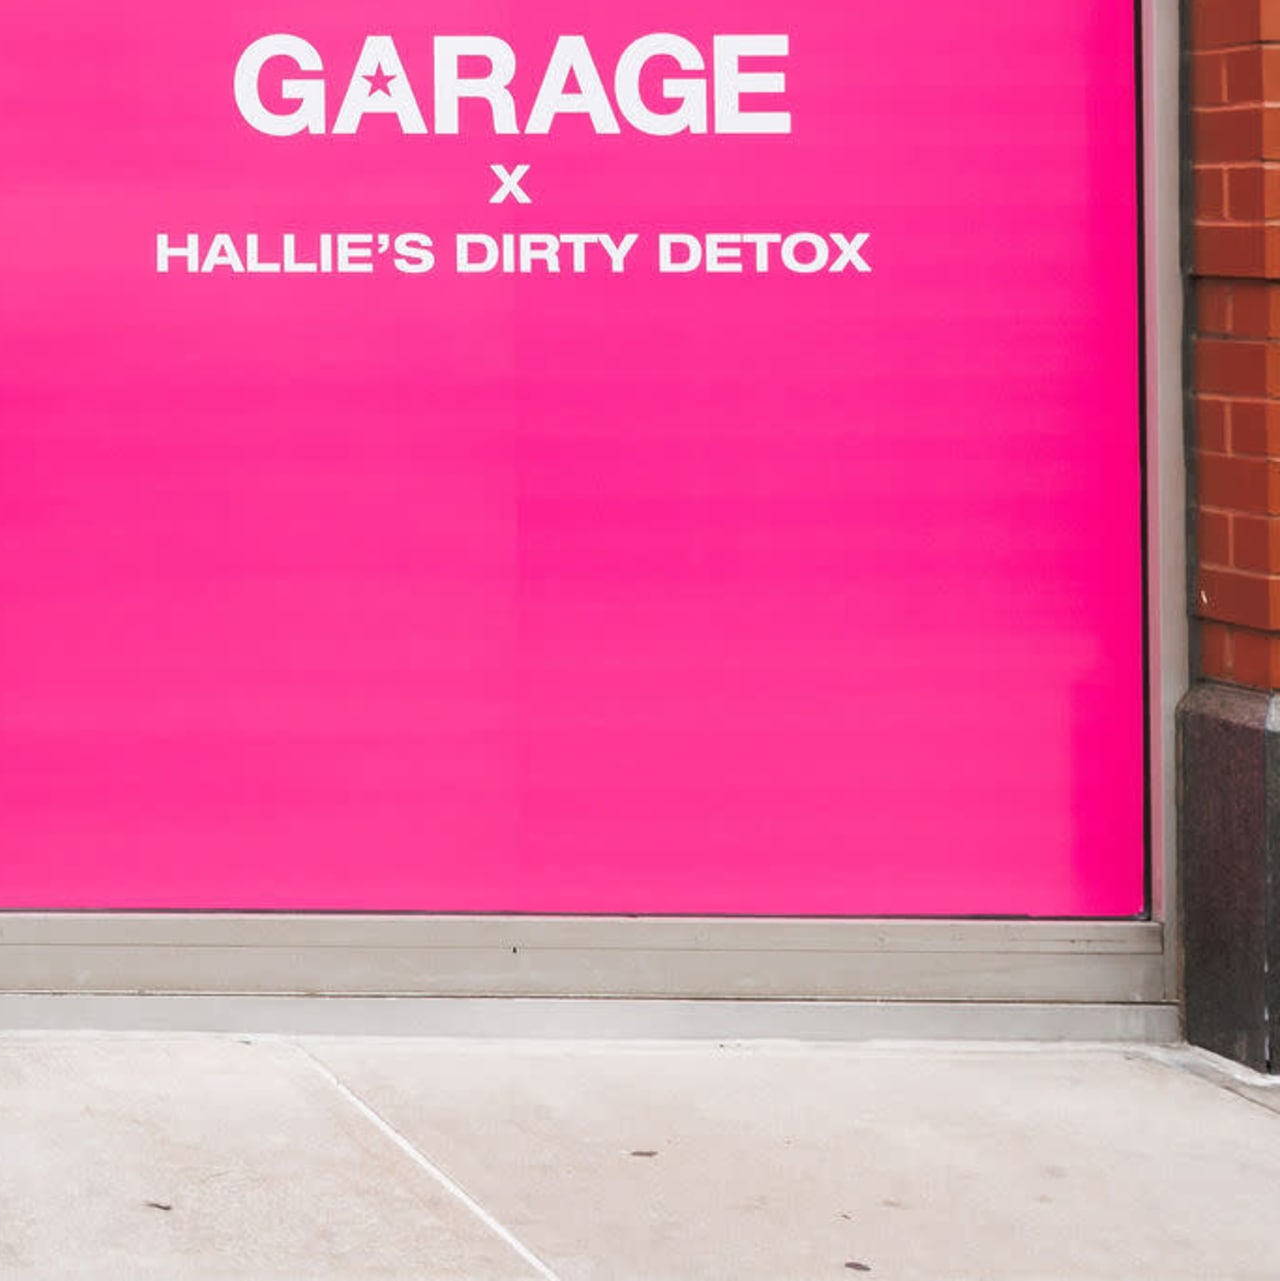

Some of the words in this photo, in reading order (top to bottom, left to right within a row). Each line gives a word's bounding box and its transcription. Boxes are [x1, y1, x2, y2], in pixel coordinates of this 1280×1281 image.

[233, 32, 792, 137] GARAGE
[156, 232, 436, 274] HALLIE’S
[455, 233, 639, 273] DIRTY
[658, 231, 872, 274] DETOX
